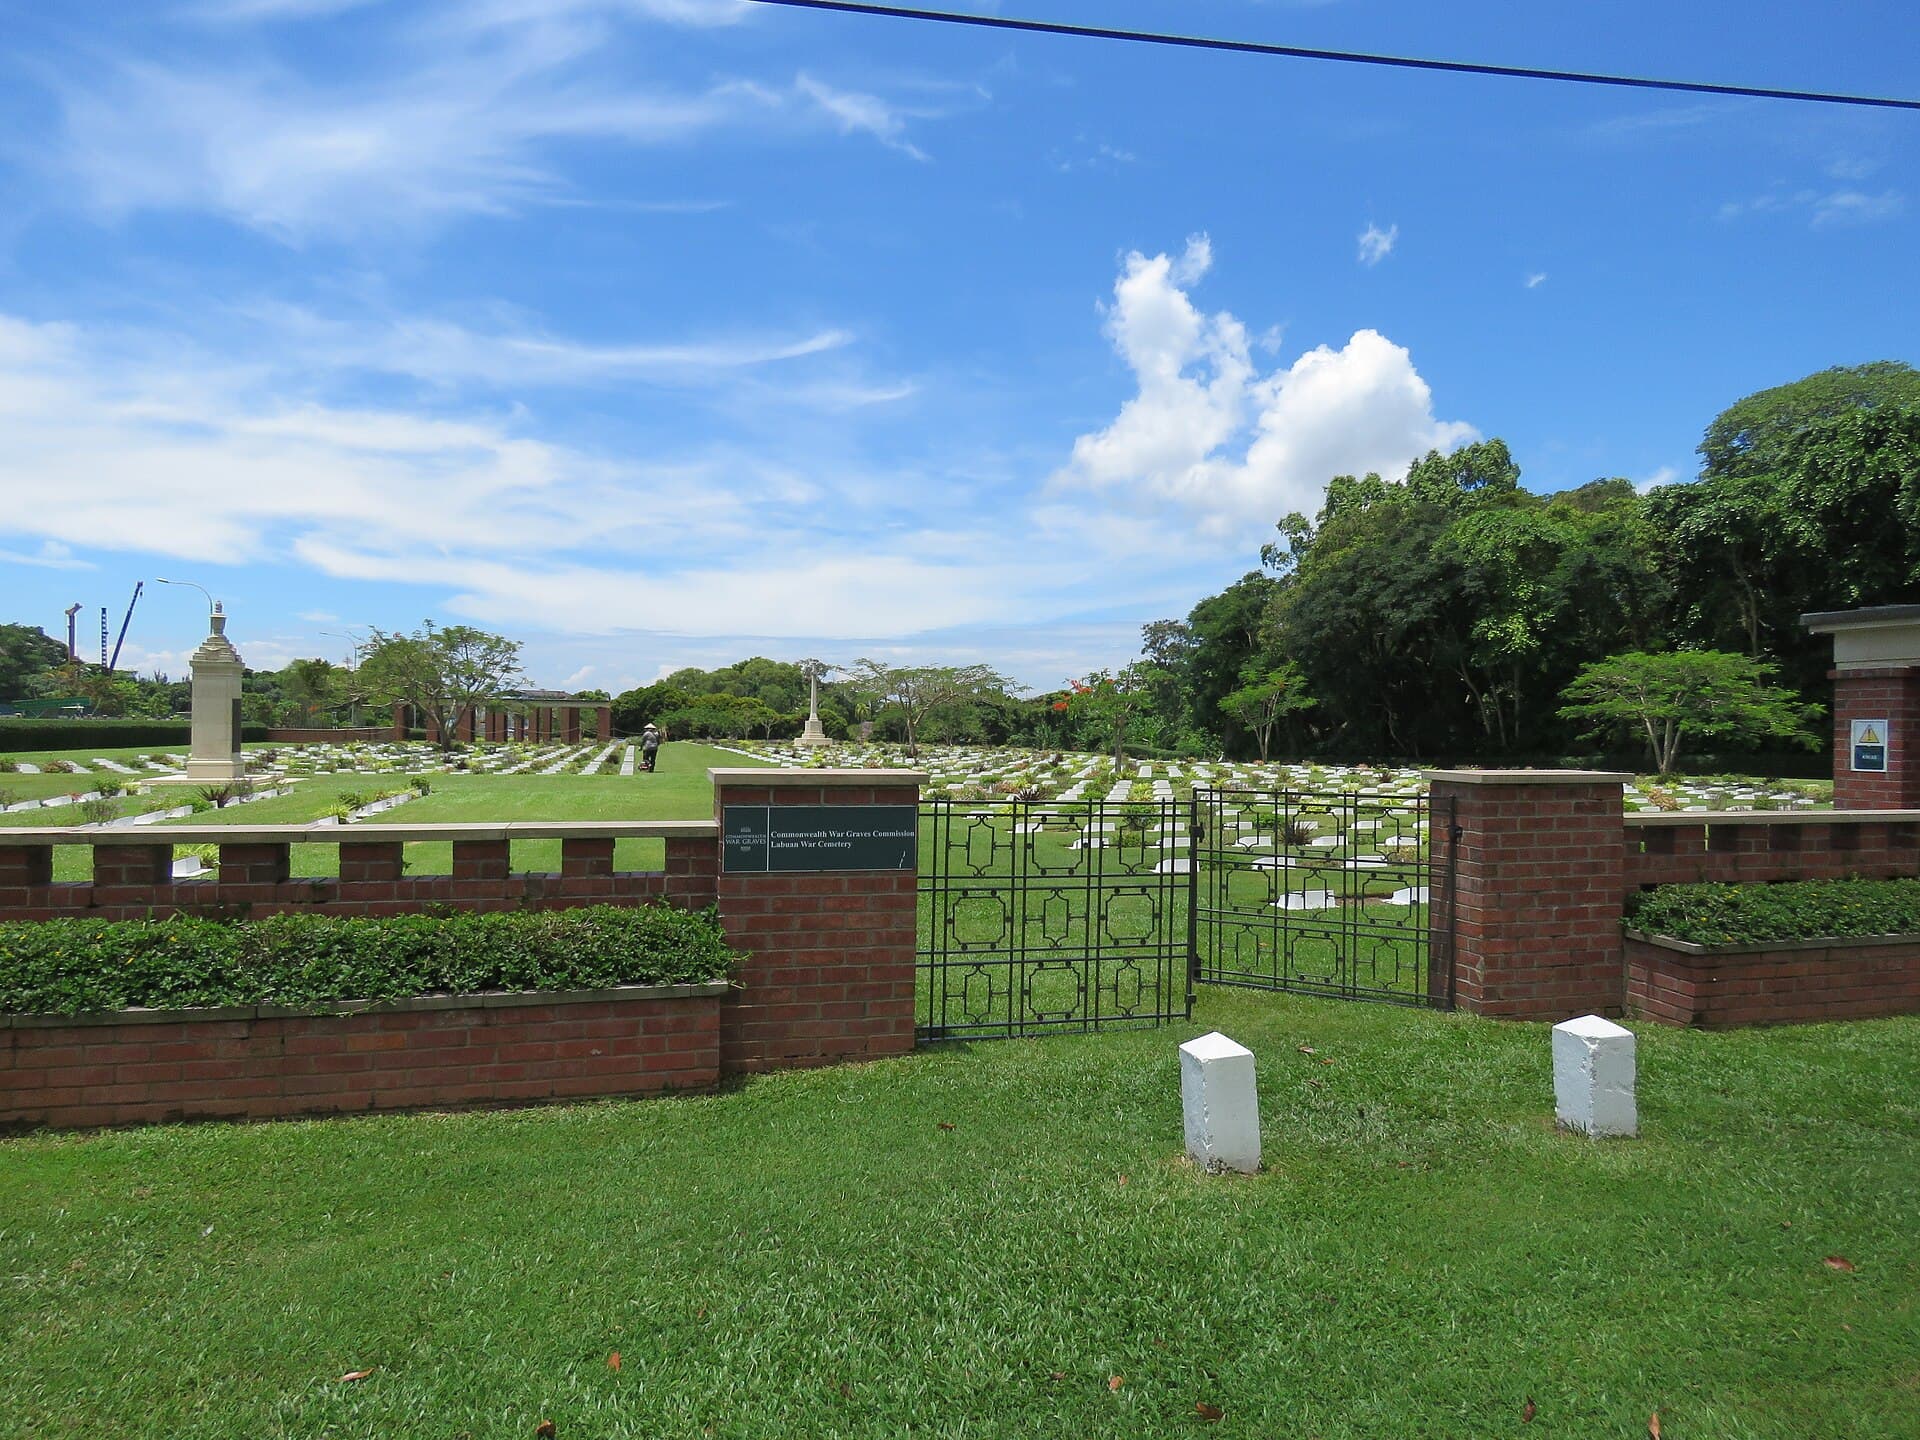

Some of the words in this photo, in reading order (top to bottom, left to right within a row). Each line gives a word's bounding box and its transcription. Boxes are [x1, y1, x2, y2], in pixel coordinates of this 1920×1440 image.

[828, 830, 845, 838] War
[846, 830, 871, 838] Graves
[872, 829, 915, 838] Commission
[770, 840, 799, 848] Labuan
[800, 840, 816, 848] War
[817, 840, 852, 849] Cemetery
